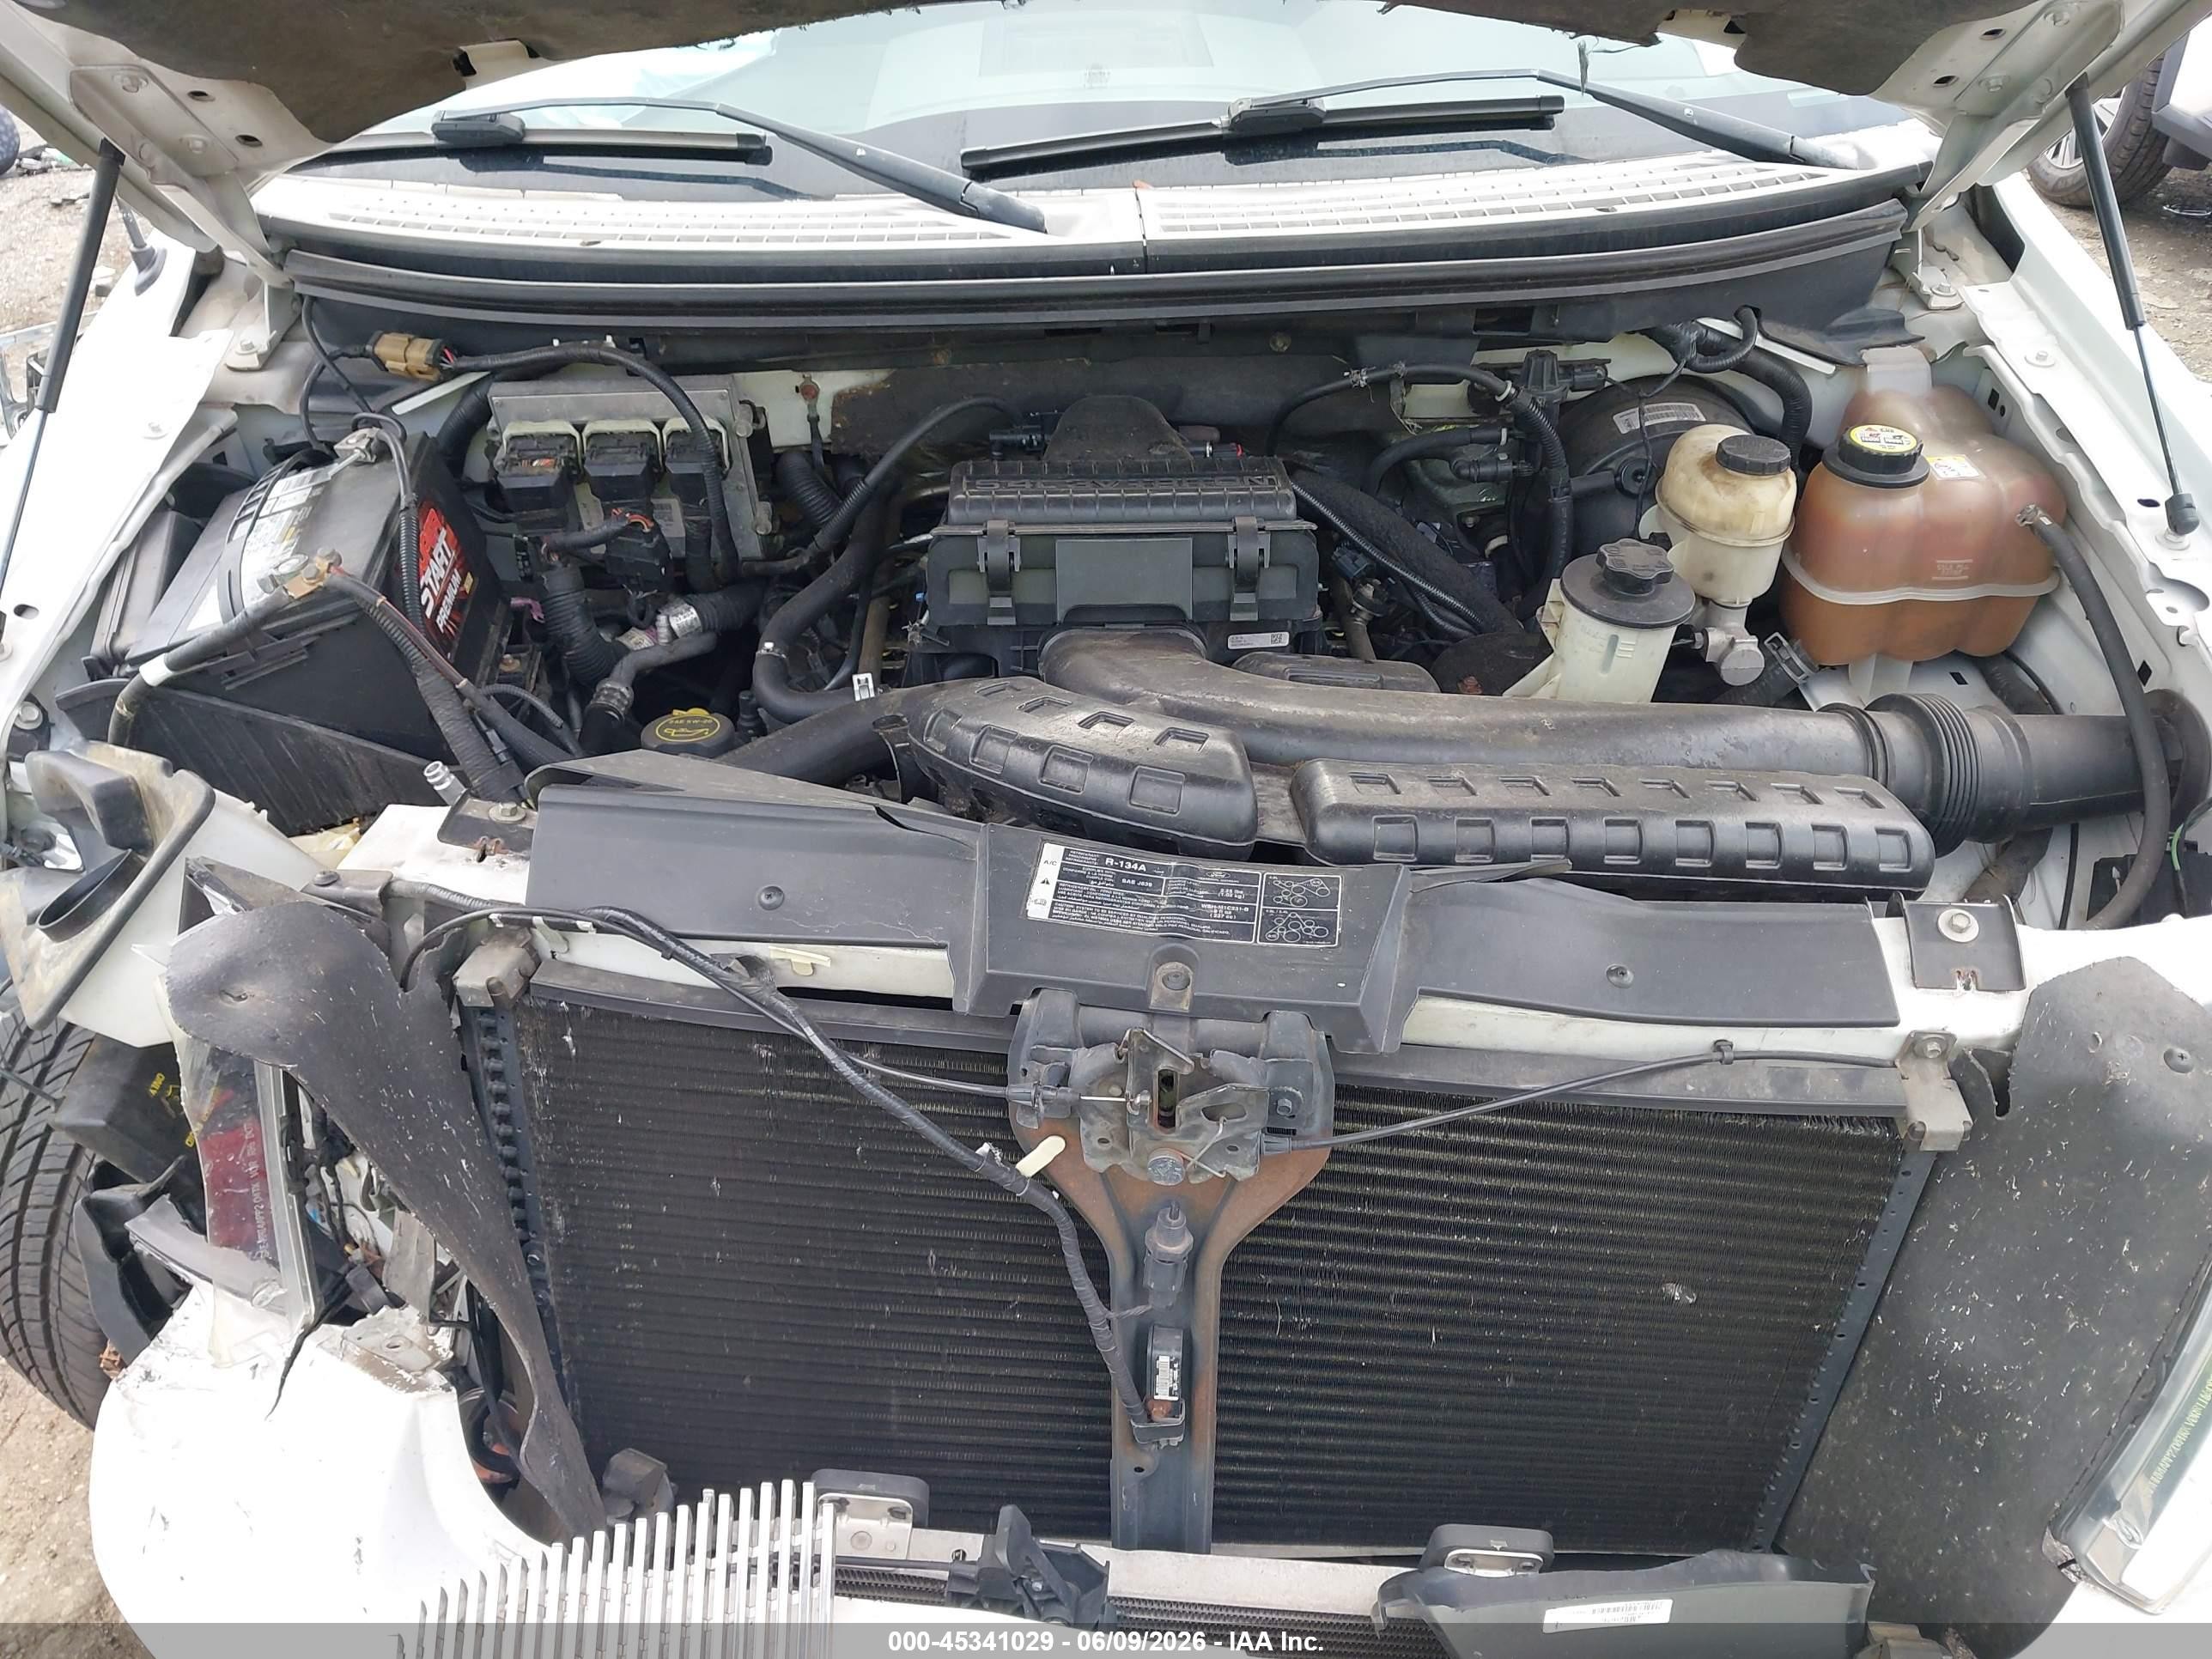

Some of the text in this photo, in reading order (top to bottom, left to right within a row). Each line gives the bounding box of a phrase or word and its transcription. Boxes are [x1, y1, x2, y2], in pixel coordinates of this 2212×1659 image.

[420, 526, 455, 619] START
[436, 568, 462, 634] PREMIUM
[1105, 857, 1146, 872] R-134A
